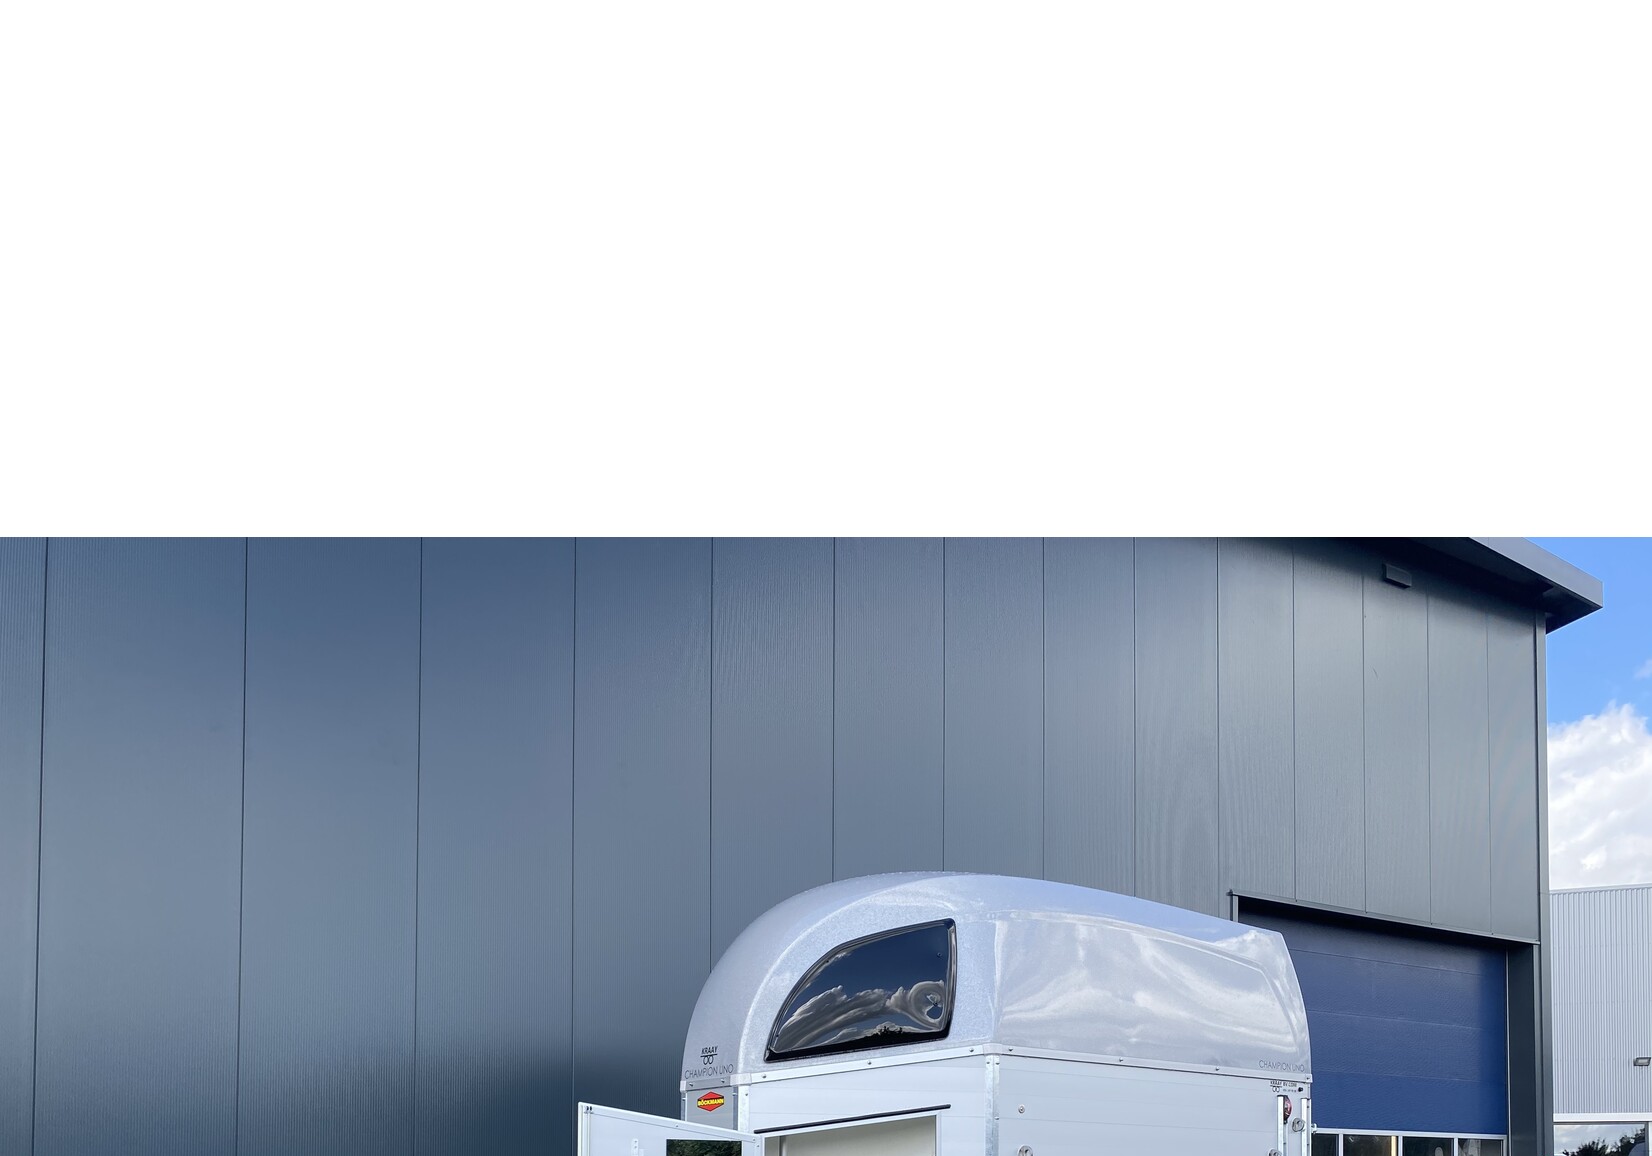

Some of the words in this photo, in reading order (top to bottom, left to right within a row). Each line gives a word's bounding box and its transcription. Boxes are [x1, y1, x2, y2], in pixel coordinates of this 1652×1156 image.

[701, 1046, 718, 1055] KRAAY
[1258, 1060, 1291, 1071] CHAMPION
[1292, 1064, 1305, 1073] UNO
[684, 1065, 718, 1080] CHAMPION
[697, 1098, 725, 1107] BÖCKMANN
